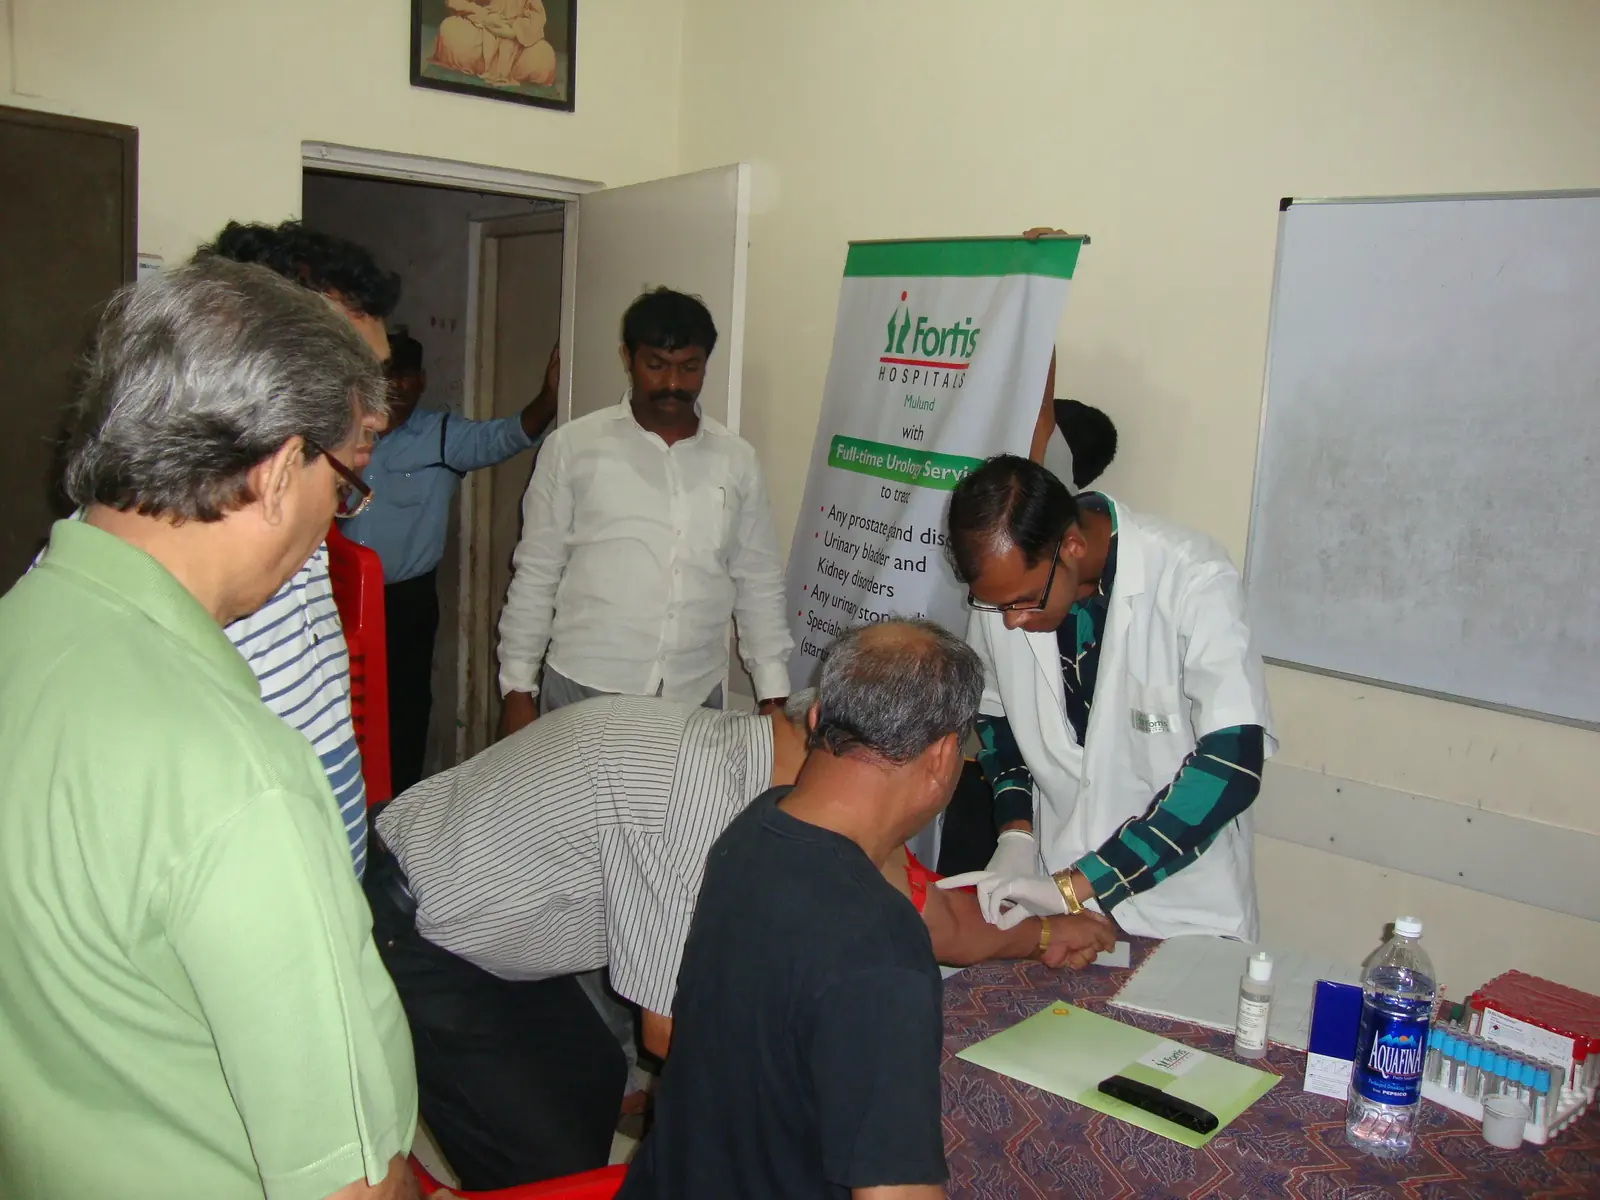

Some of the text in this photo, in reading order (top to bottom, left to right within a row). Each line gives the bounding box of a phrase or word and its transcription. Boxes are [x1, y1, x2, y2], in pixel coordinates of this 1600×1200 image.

[912, 316, 981, 358] Fortis
[878, 366, 966, 389] HOSPITALS
[904, 395, 935, 412] Mulund
[902, 425, 924, 442] with
[836, 444, 883, 468] Full-time
[880, 485, 892, 499] to
[828, 504, 848, 526] Any
[848, 514, 888, 535] prostate
[920, 528, 949, 546] dis
[824, 530, 860, 560] Urinary
[894, 556, 926, 573] and
[817, 556, 894, 597] Kidney disorders
[811, 584, 830, 608] Any
[832, 596, 859, 620] urinary
[1368, 1029, 1423, 1079] AQUAFINA
